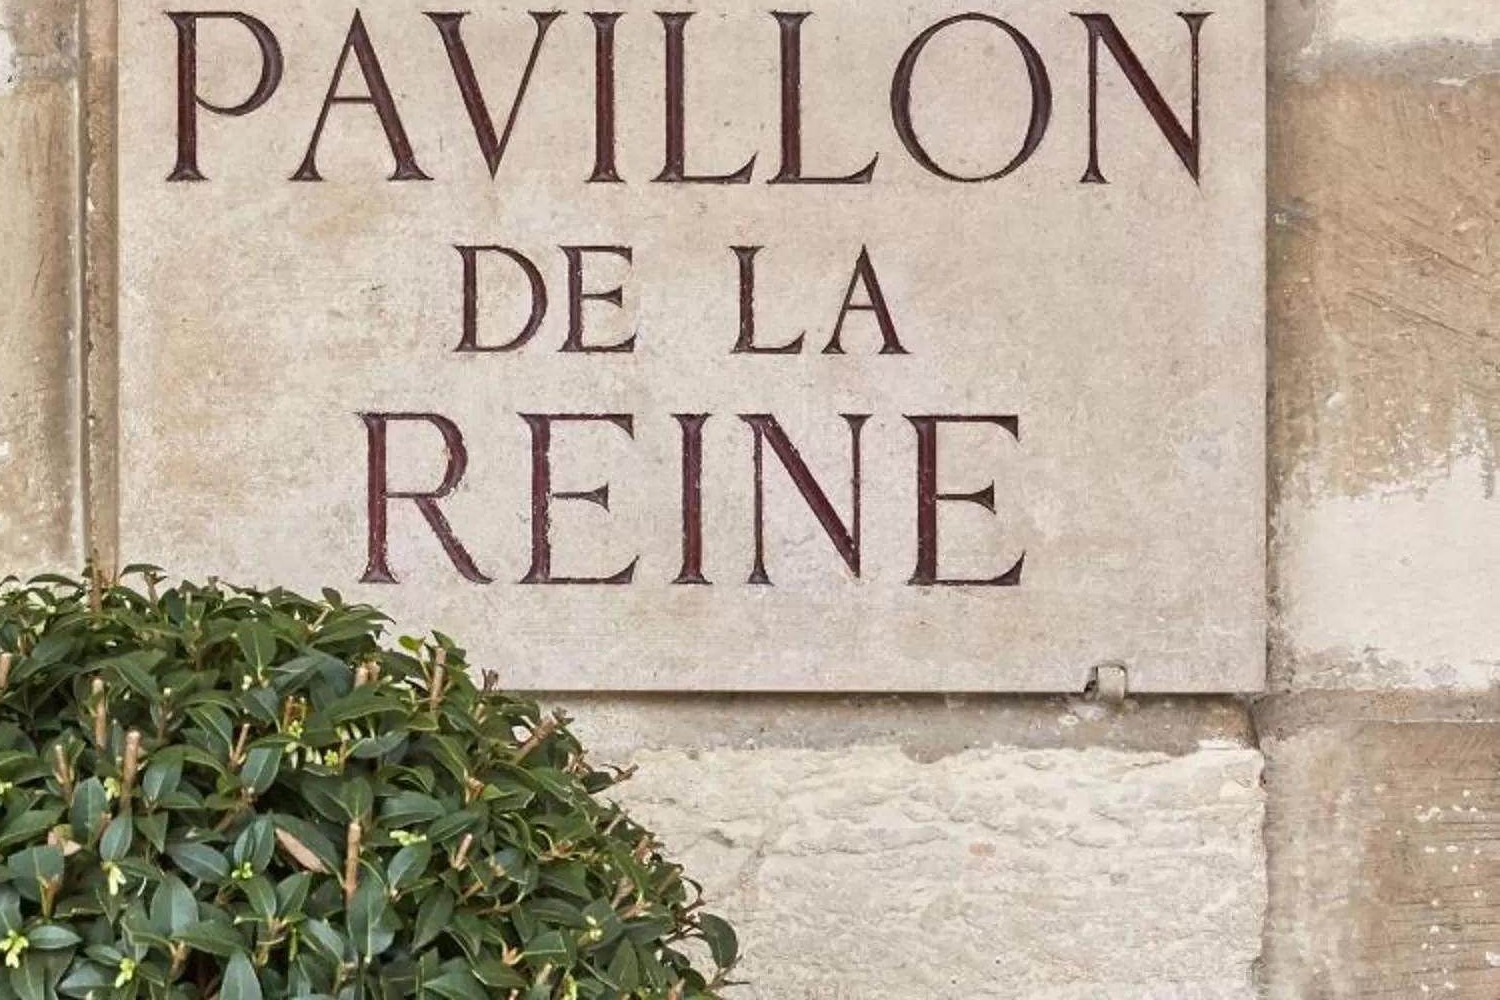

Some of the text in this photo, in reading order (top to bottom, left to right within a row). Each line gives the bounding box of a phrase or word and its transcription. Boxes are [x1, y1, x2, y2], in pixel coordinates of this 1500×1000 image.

[163, 8, 1213, 186] PAVILLON
[453, 244, 911, 355] DE LA
[357, 411, 1026, 587] REINE
